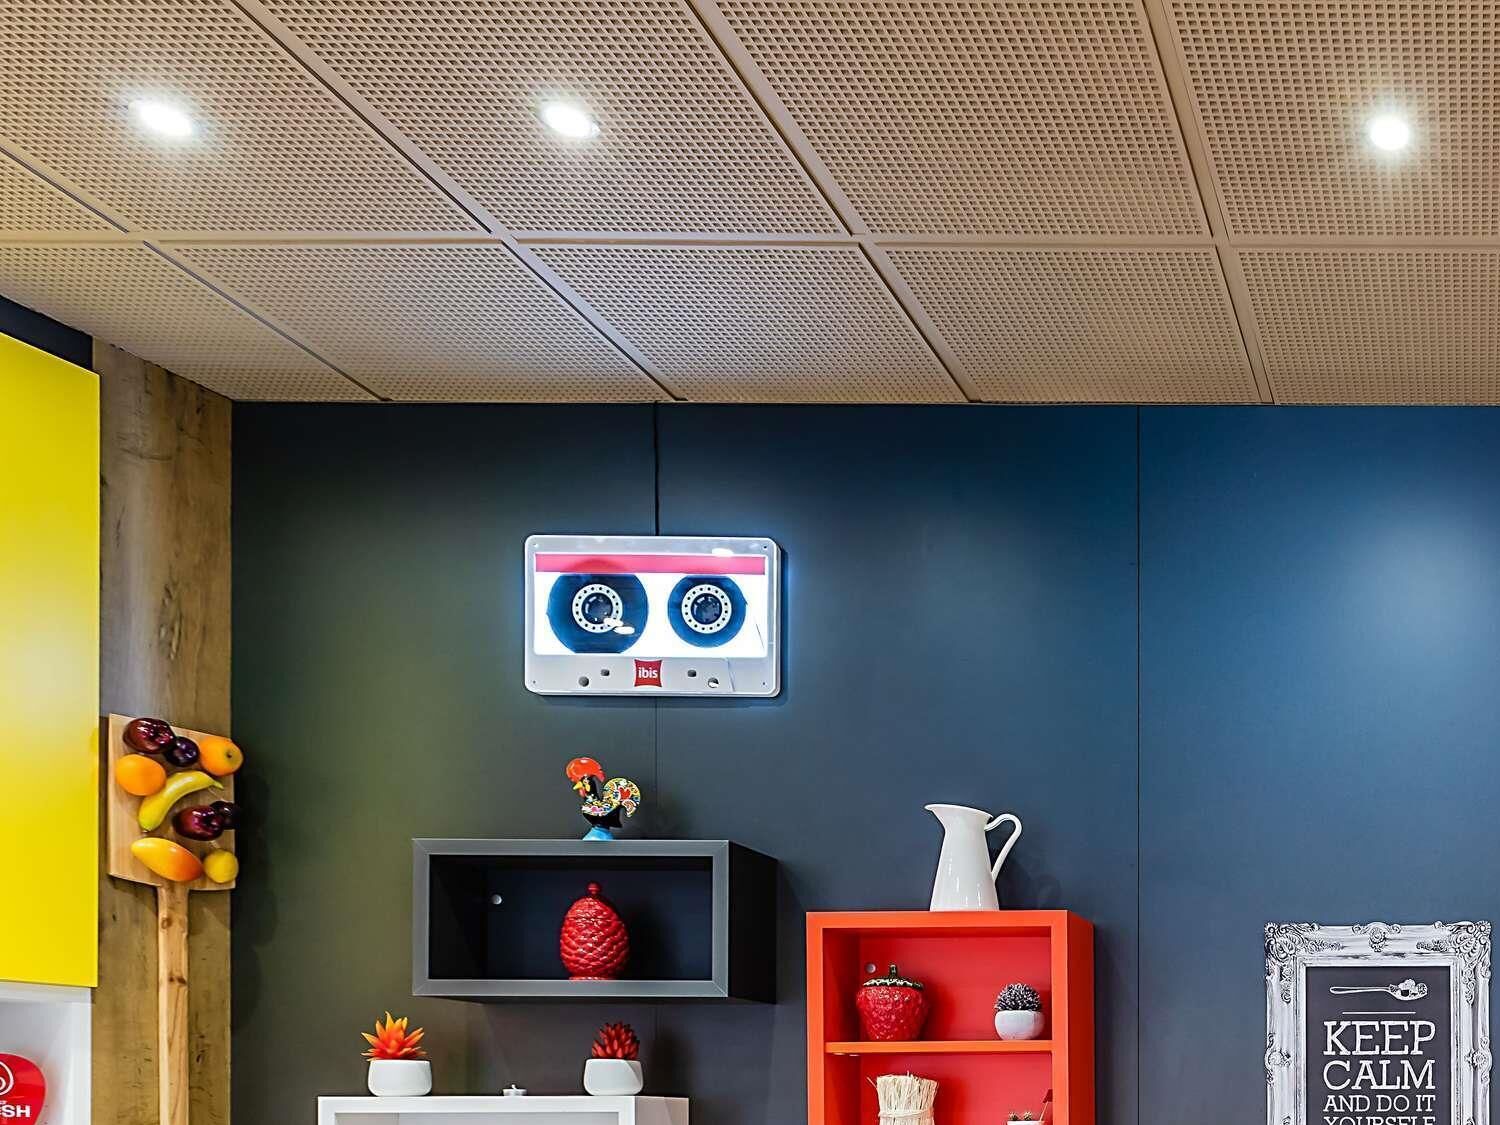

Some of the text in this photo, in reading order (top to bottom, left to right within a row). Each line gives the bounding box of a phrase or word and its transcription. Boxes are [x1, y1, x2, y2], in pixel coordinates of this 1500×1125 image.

[637, 666, 658, 679] ibis
[1323, 1020, 1436, 1056] KEEP
[1323, 1059, 1436, 1091] CALM
[1323, 1095, 1436, 1113] AND DO IT
